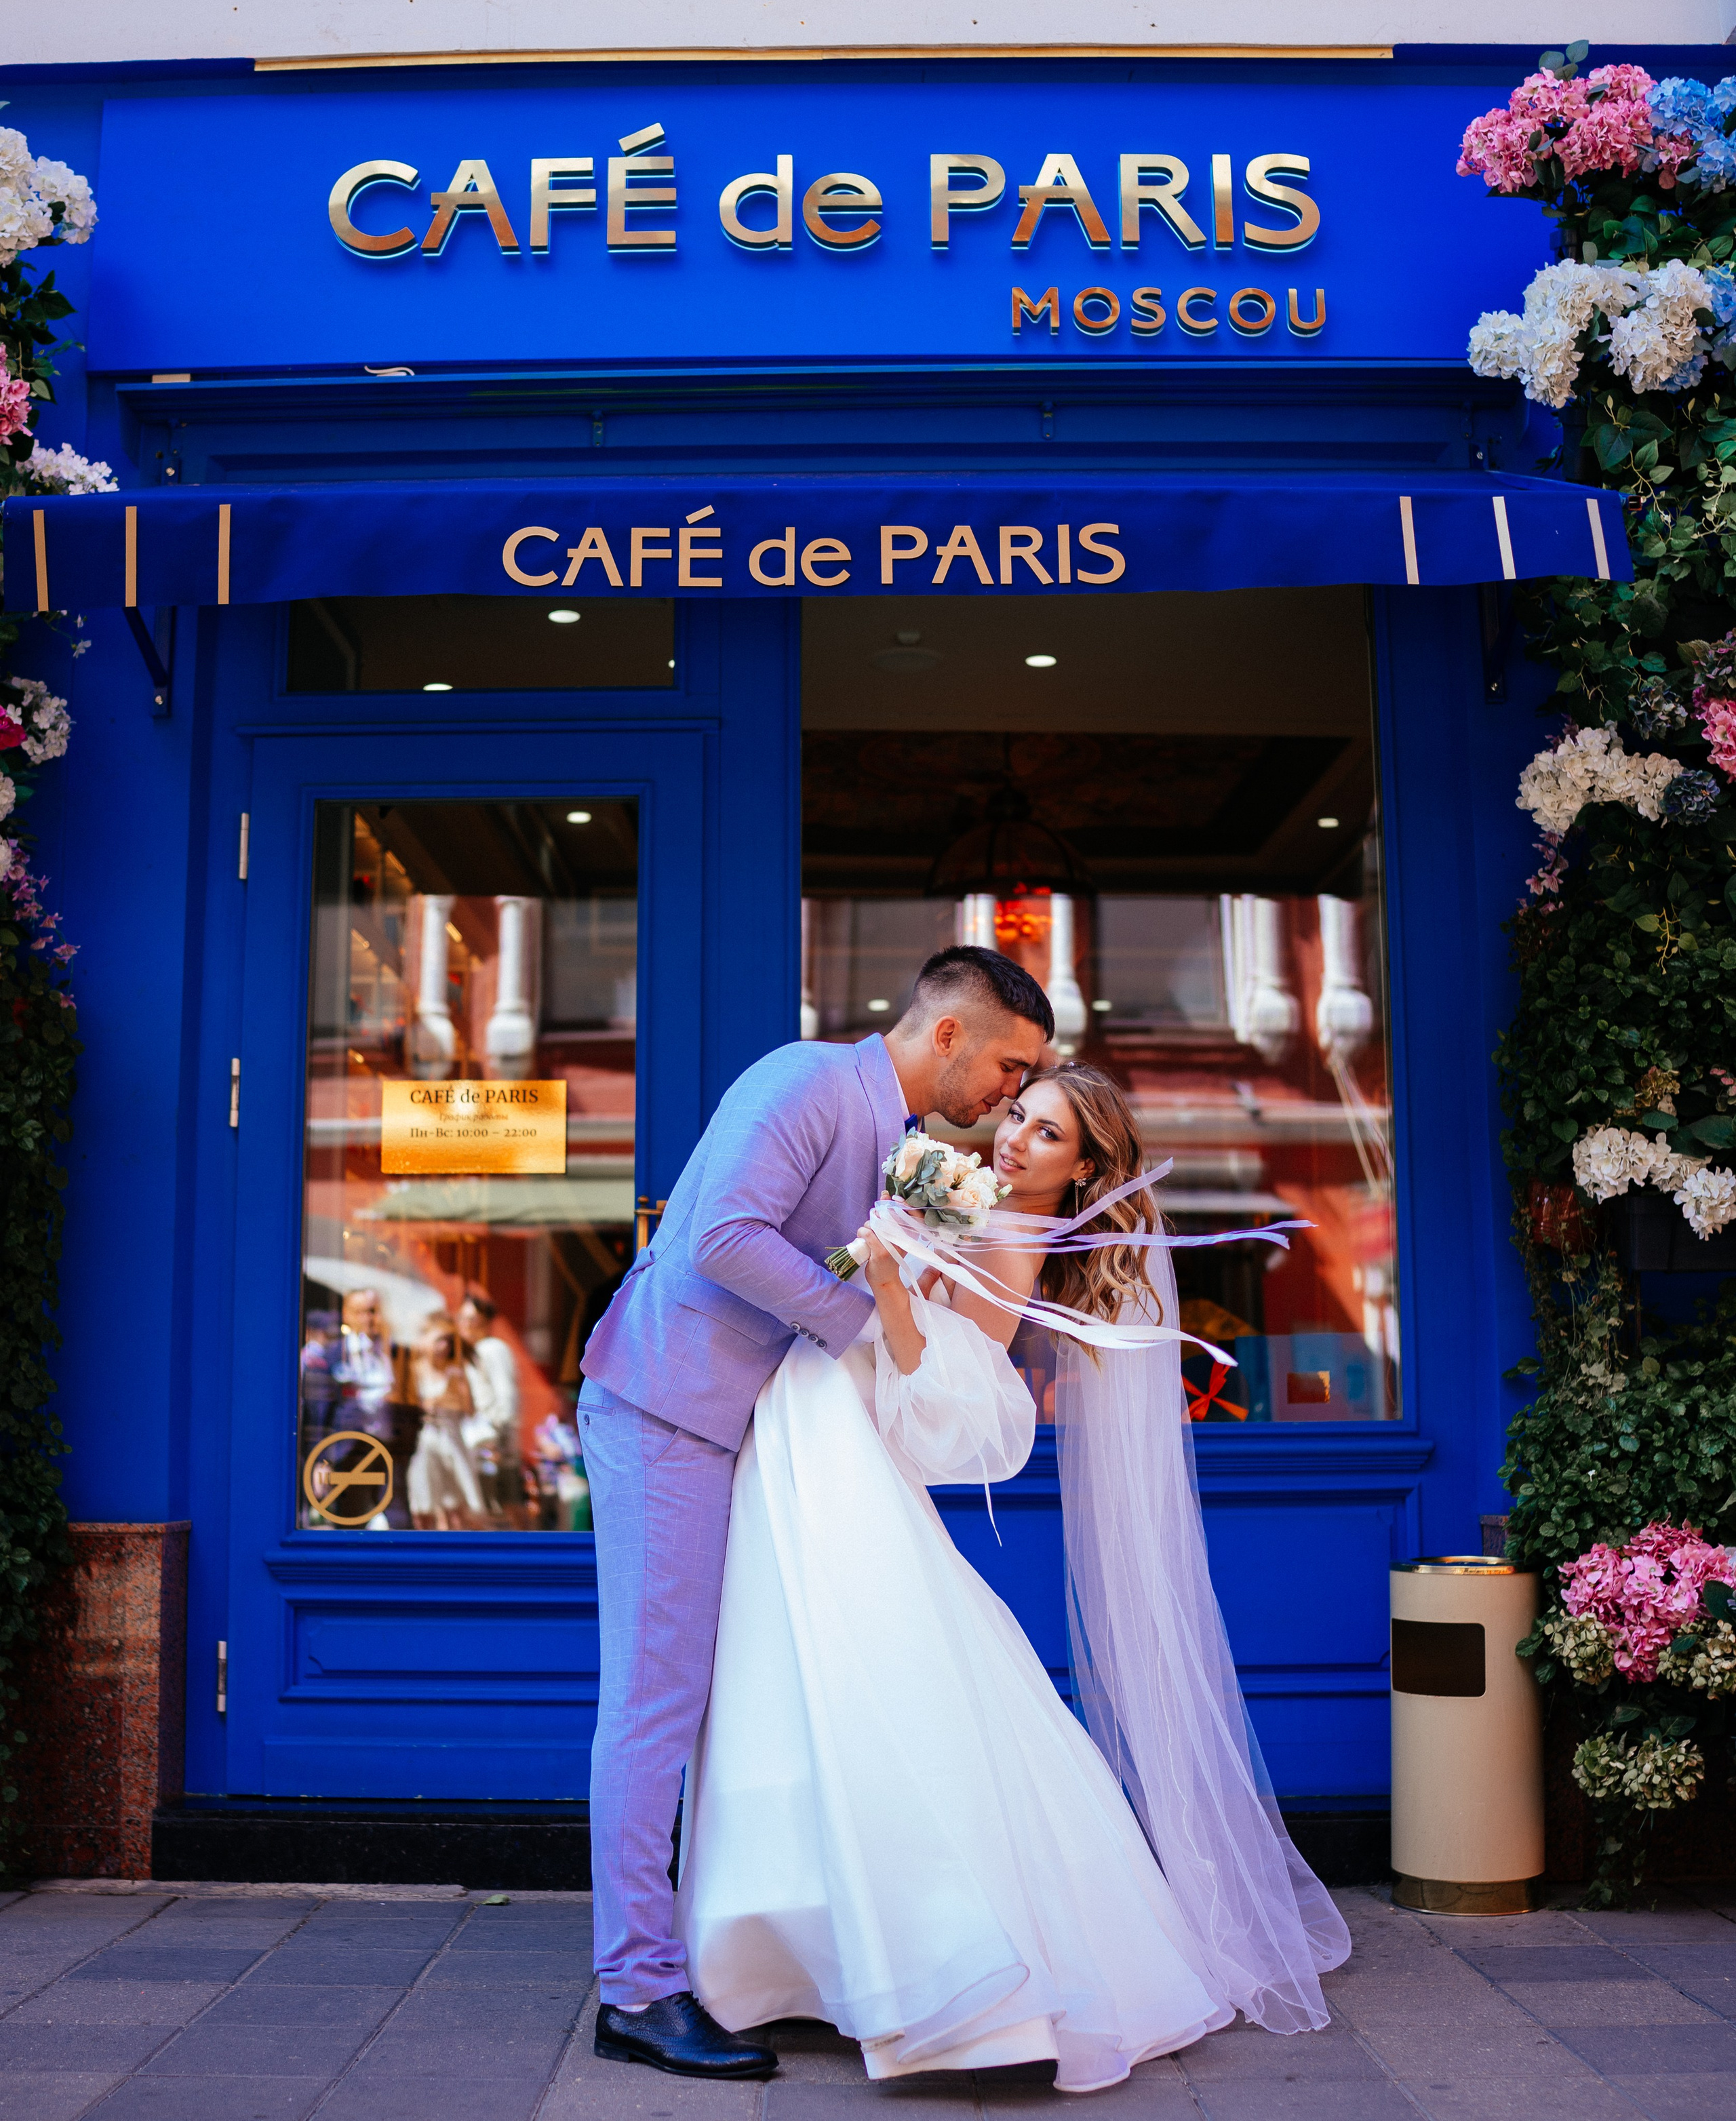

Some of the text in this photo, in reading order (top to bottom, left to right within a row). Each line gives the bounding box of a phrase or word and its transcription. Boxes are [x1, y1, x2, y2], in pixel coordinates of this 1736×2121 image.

[328, 123, 1321, 255] CAFÉ de PARIS
[1012, 286, 1326, 338] MOSCOU
[502, 505, 1126, 587] CAFÉ de PARIS
[410, 1086, 538, 1104] CAFÉ de PARIS
[456, 1128, 488, 1138] 10:00
[504, 1128, 537, 1137] 22:00
